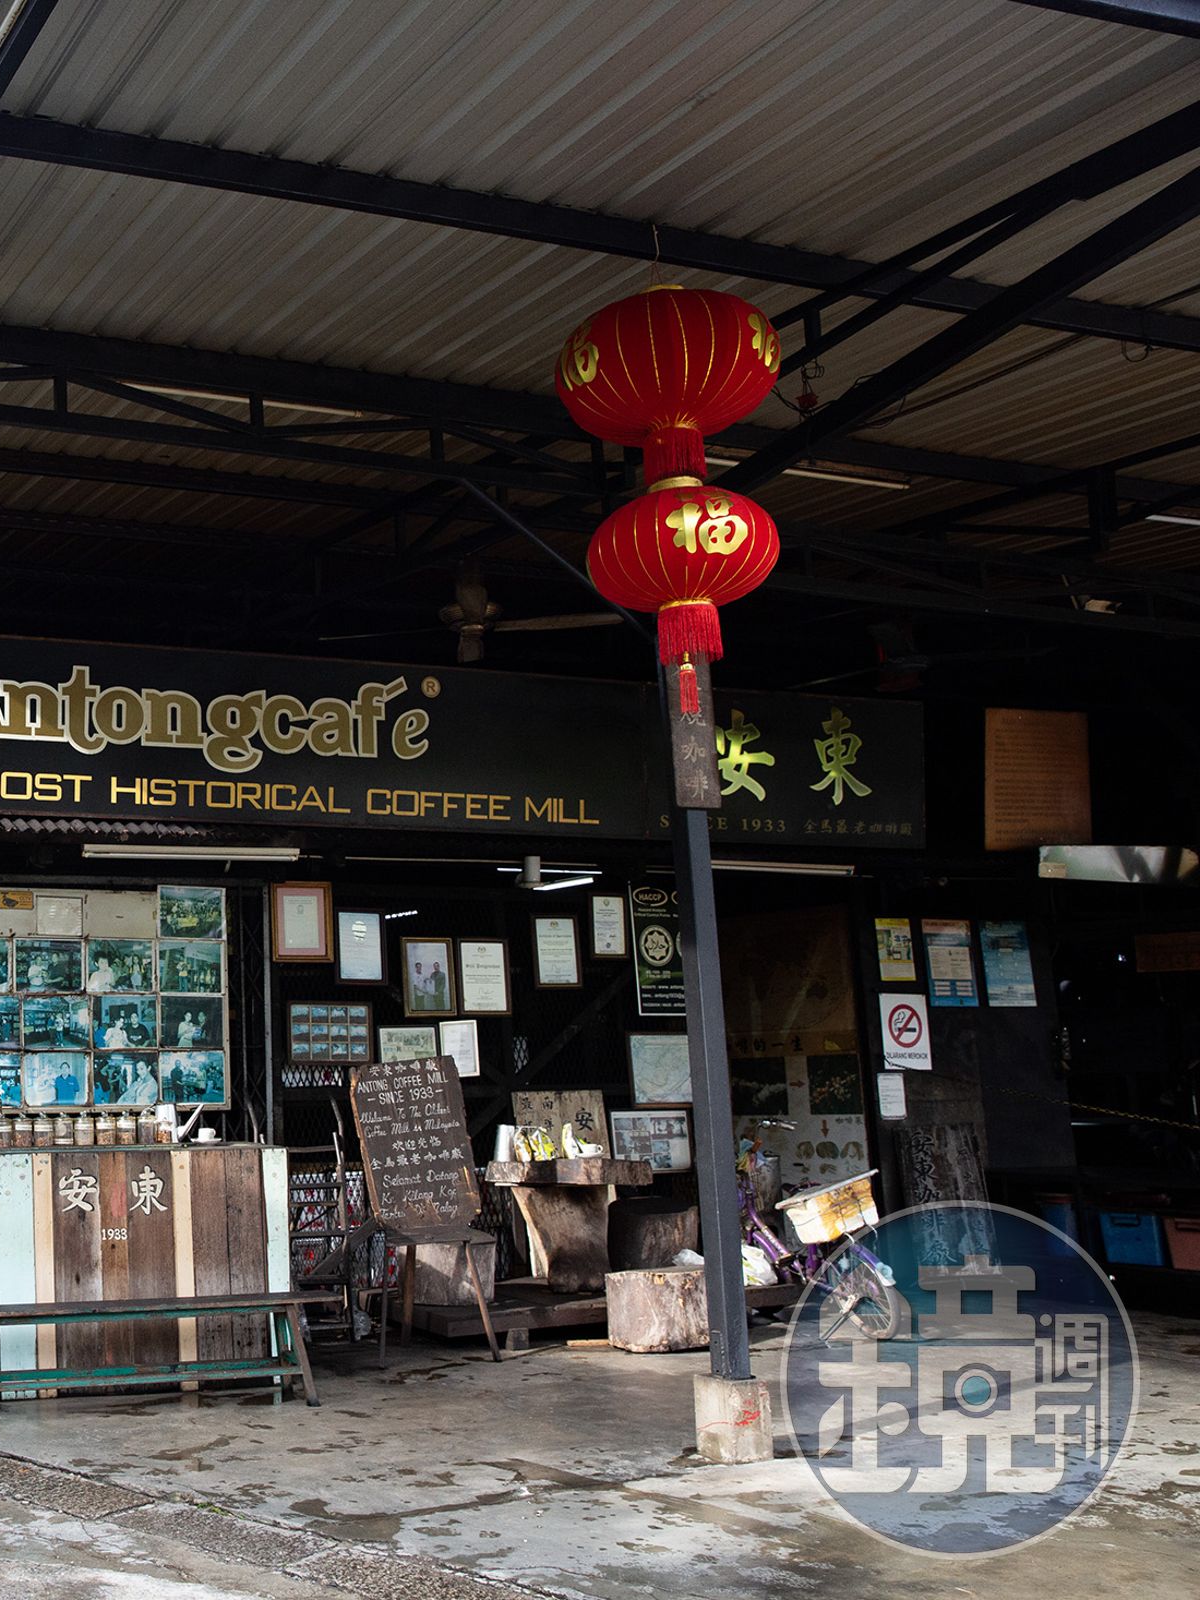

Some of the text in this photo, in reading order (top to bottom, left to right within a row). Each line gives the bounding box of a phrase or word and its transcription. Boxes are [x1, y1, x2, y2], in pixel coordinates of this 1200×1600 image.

[665, 491, 748, 555] 福
[111, 777, 350, 814] HISTORICAL
[367, 789, 510, 821] COFFEE
[526, 797, 599, 825] MILL
[741, 818, 786, 832] 1933
[638, 892, 663, 901] HACCP
[357, 1071, 449, 1094] ANTONG COFFEE MILL
[409, 1086, 434, 1101] 1933
[397, 1107, 406, 1119] To
[409, 1105, 422, 1118] The
[391, 1122, 410, 1135] Mill
[382, 1169, 459, 1188] Selamat Datang
[58, 1165, 168, 1215] 安東
[101, 1228, 128, 1240] 1933
